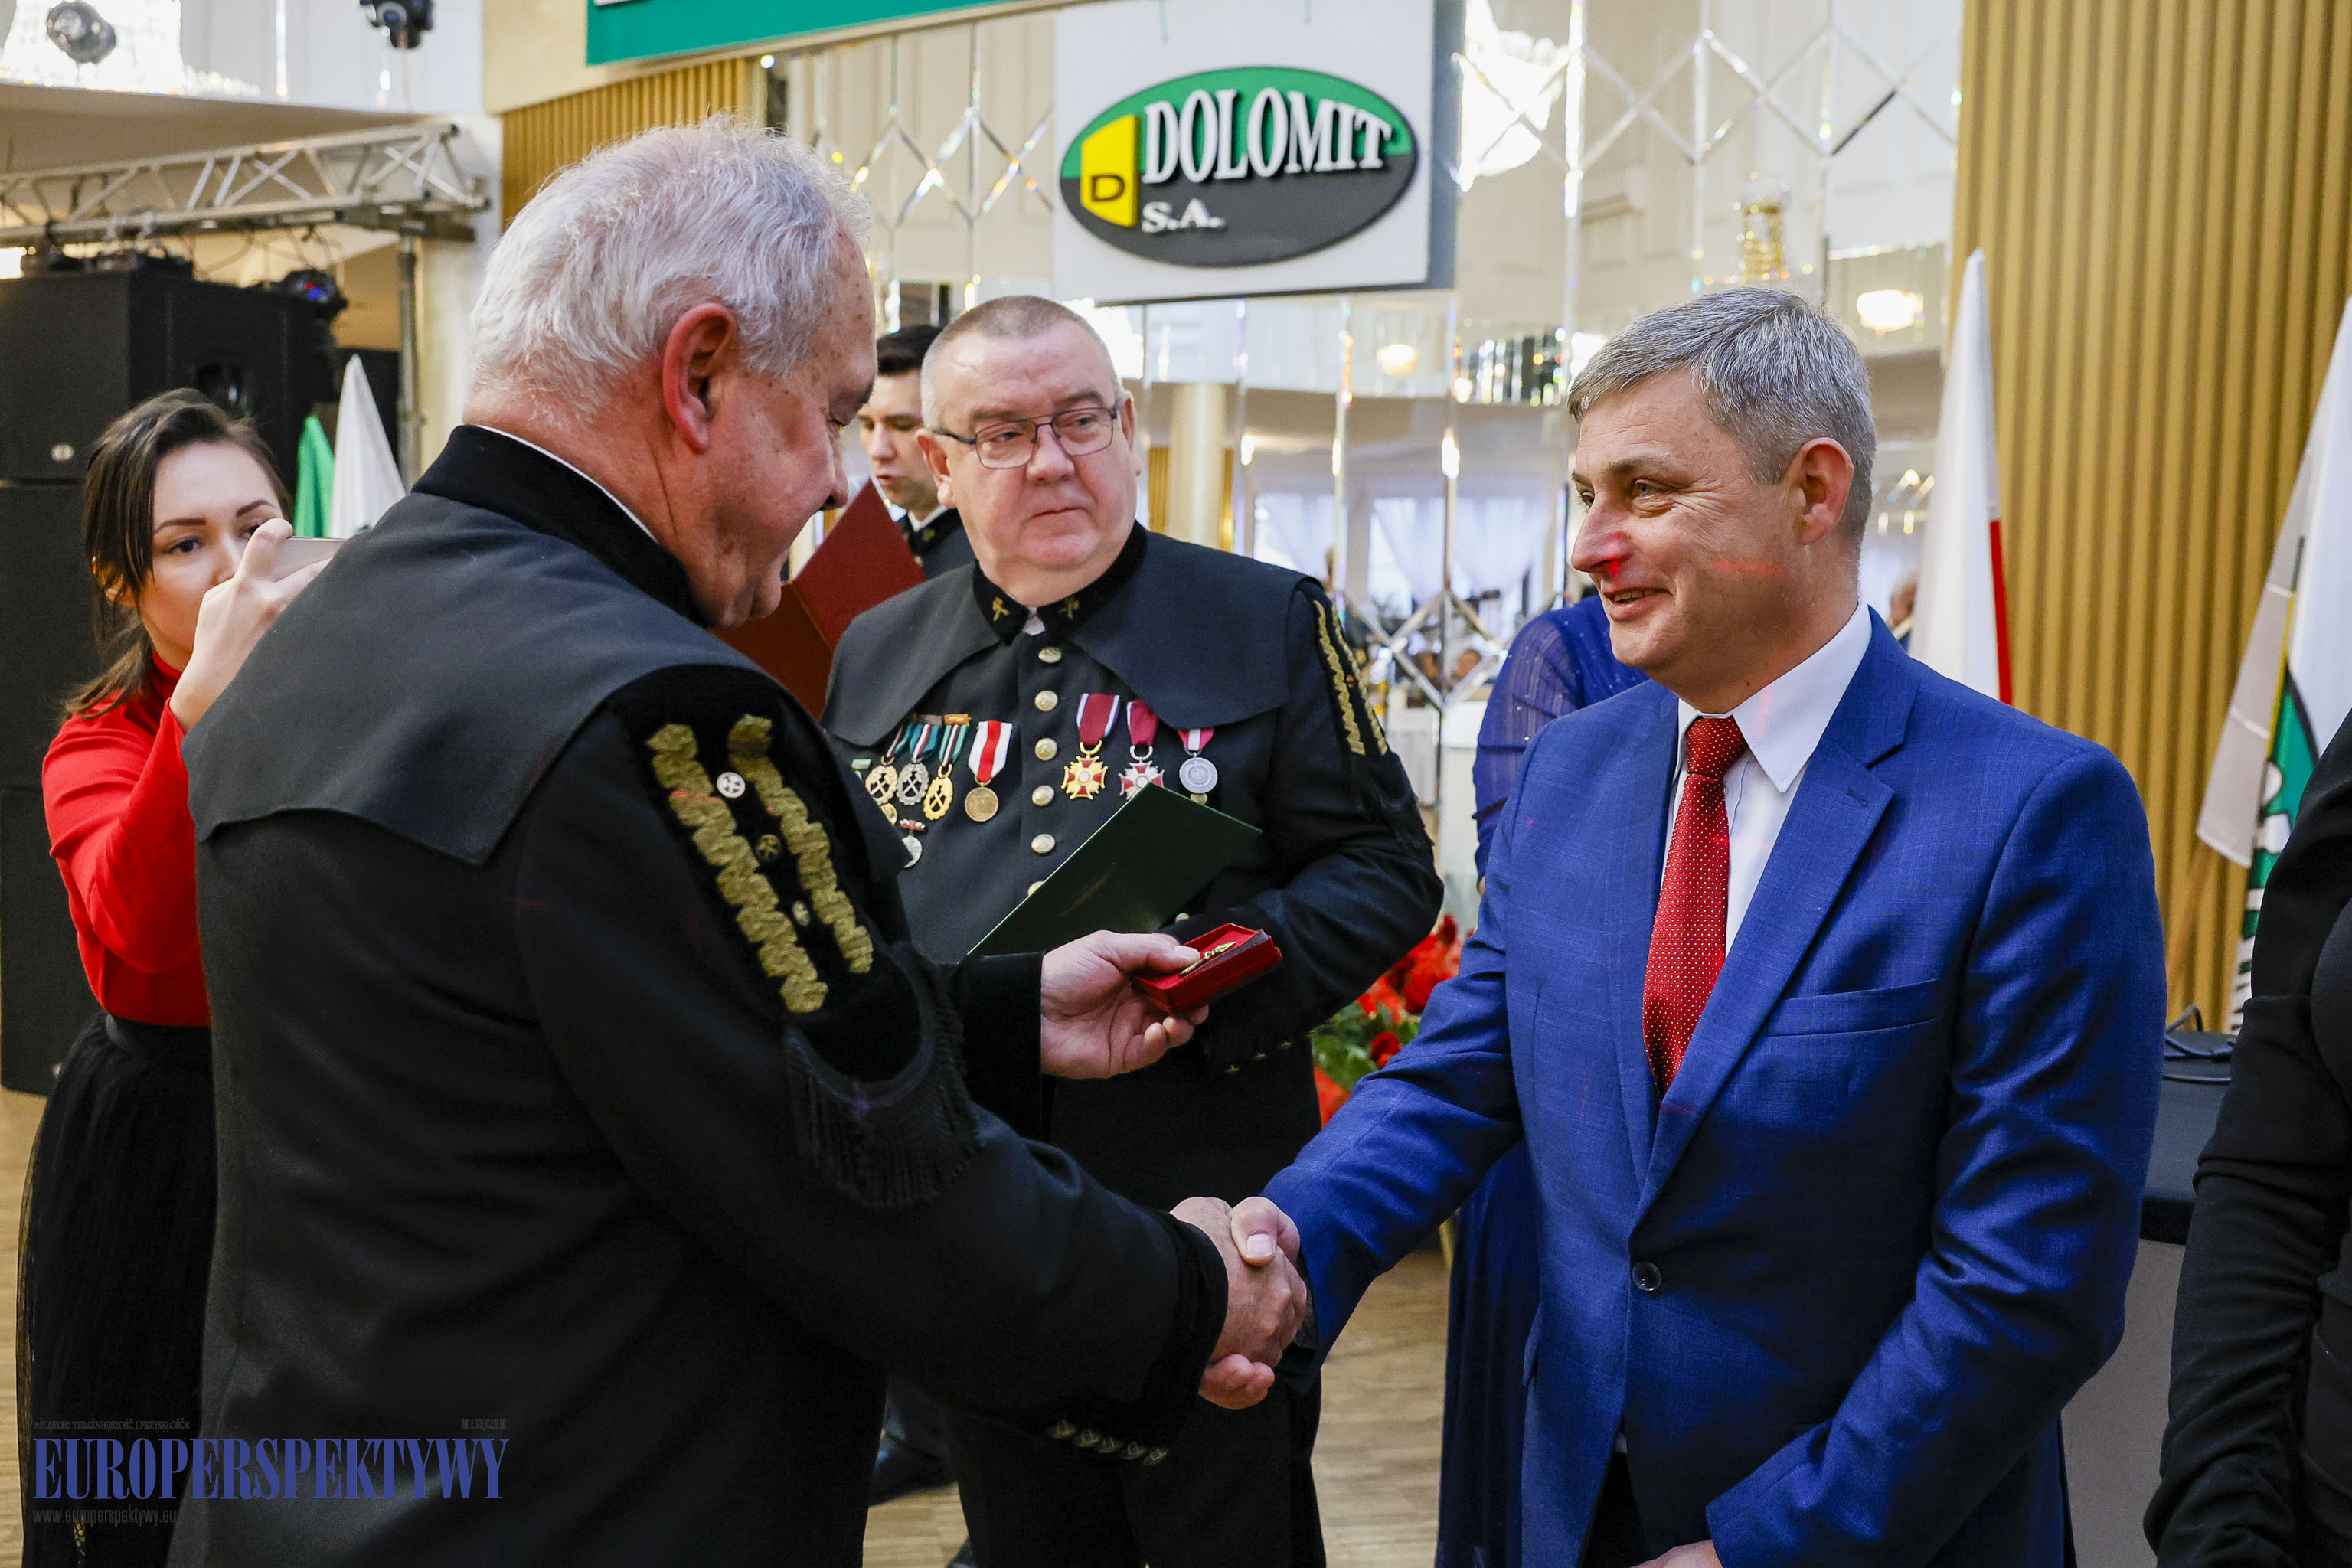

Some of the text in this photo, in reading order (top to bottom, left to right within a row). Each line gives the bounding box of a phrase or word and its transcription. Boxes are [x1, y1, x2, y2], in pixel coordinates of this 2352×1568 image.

[1142, 87, 1392, 185] DOLOMIT
[1090, 175, 1125, 201] D
[1142, 198, 1225, 233] S.A.
